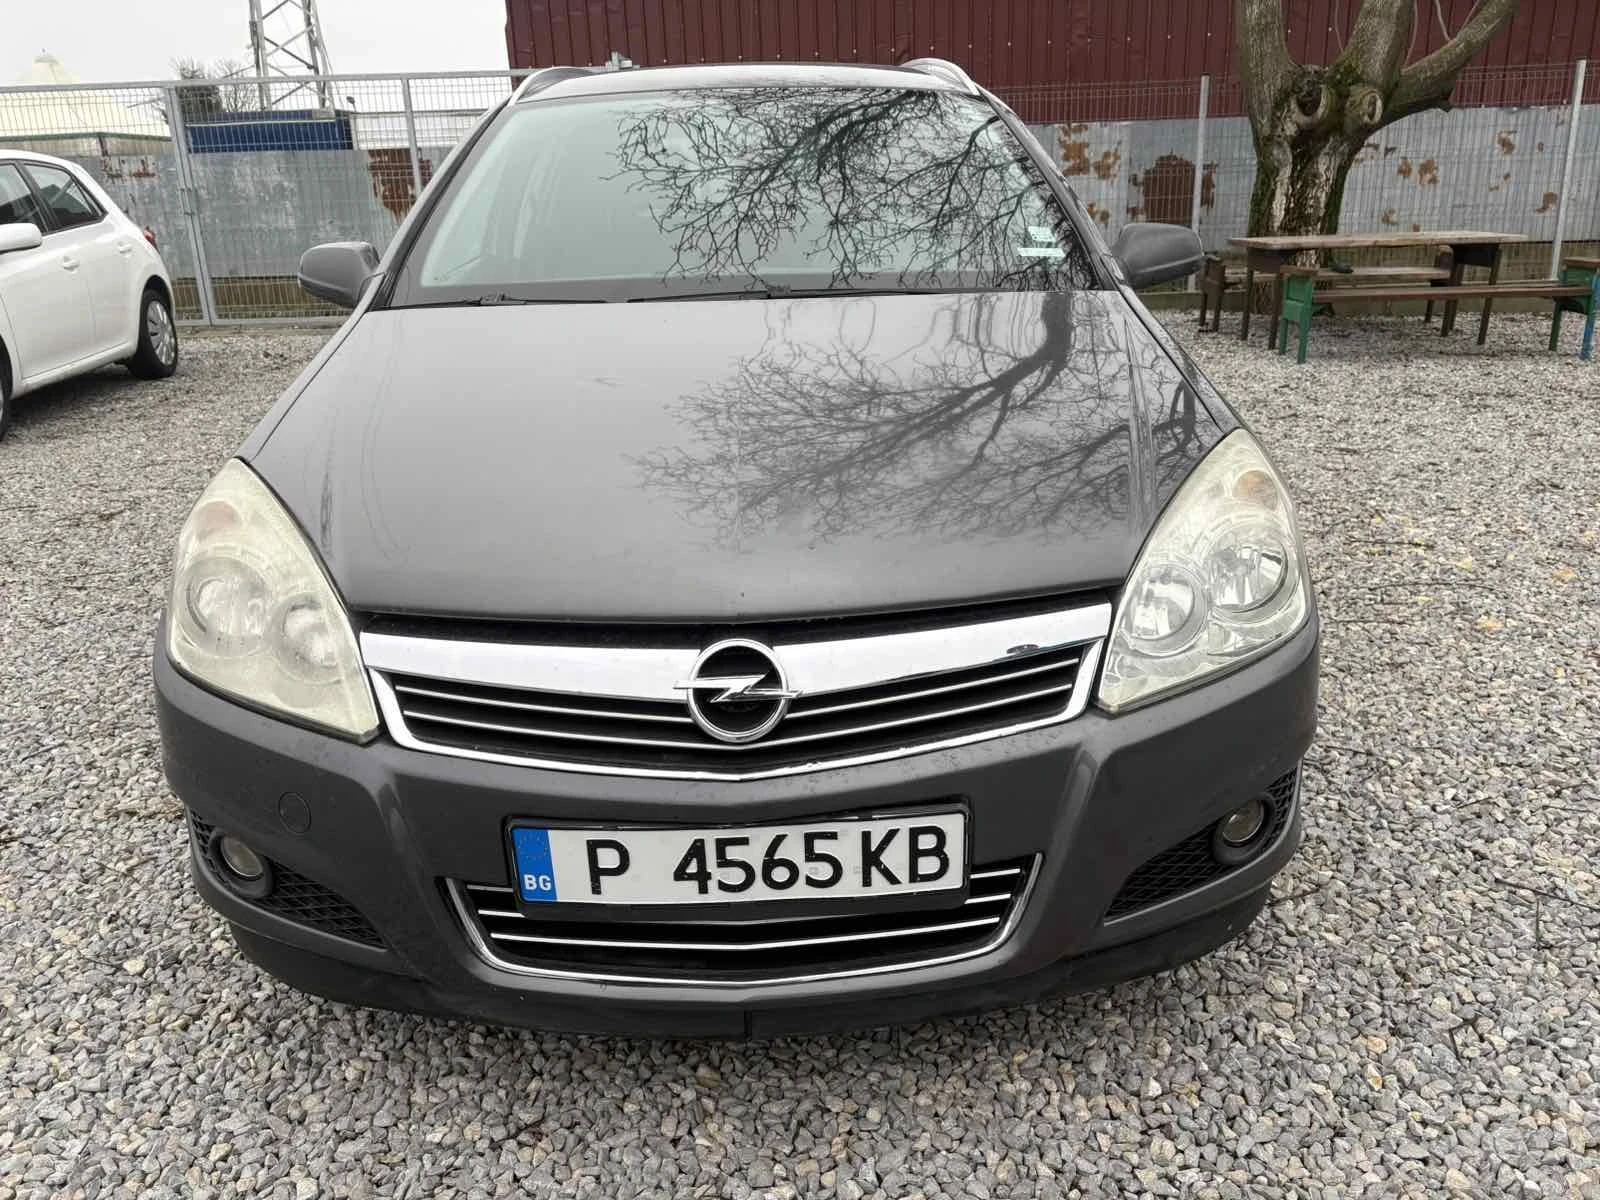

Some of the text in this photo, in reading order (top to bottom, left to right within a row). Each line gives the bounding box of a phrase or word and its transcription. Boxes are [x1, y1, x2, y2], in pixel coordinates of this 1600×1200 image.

[586, 825, 950, 895] P 4565 KB
[524, 874, 551, 892] BG
